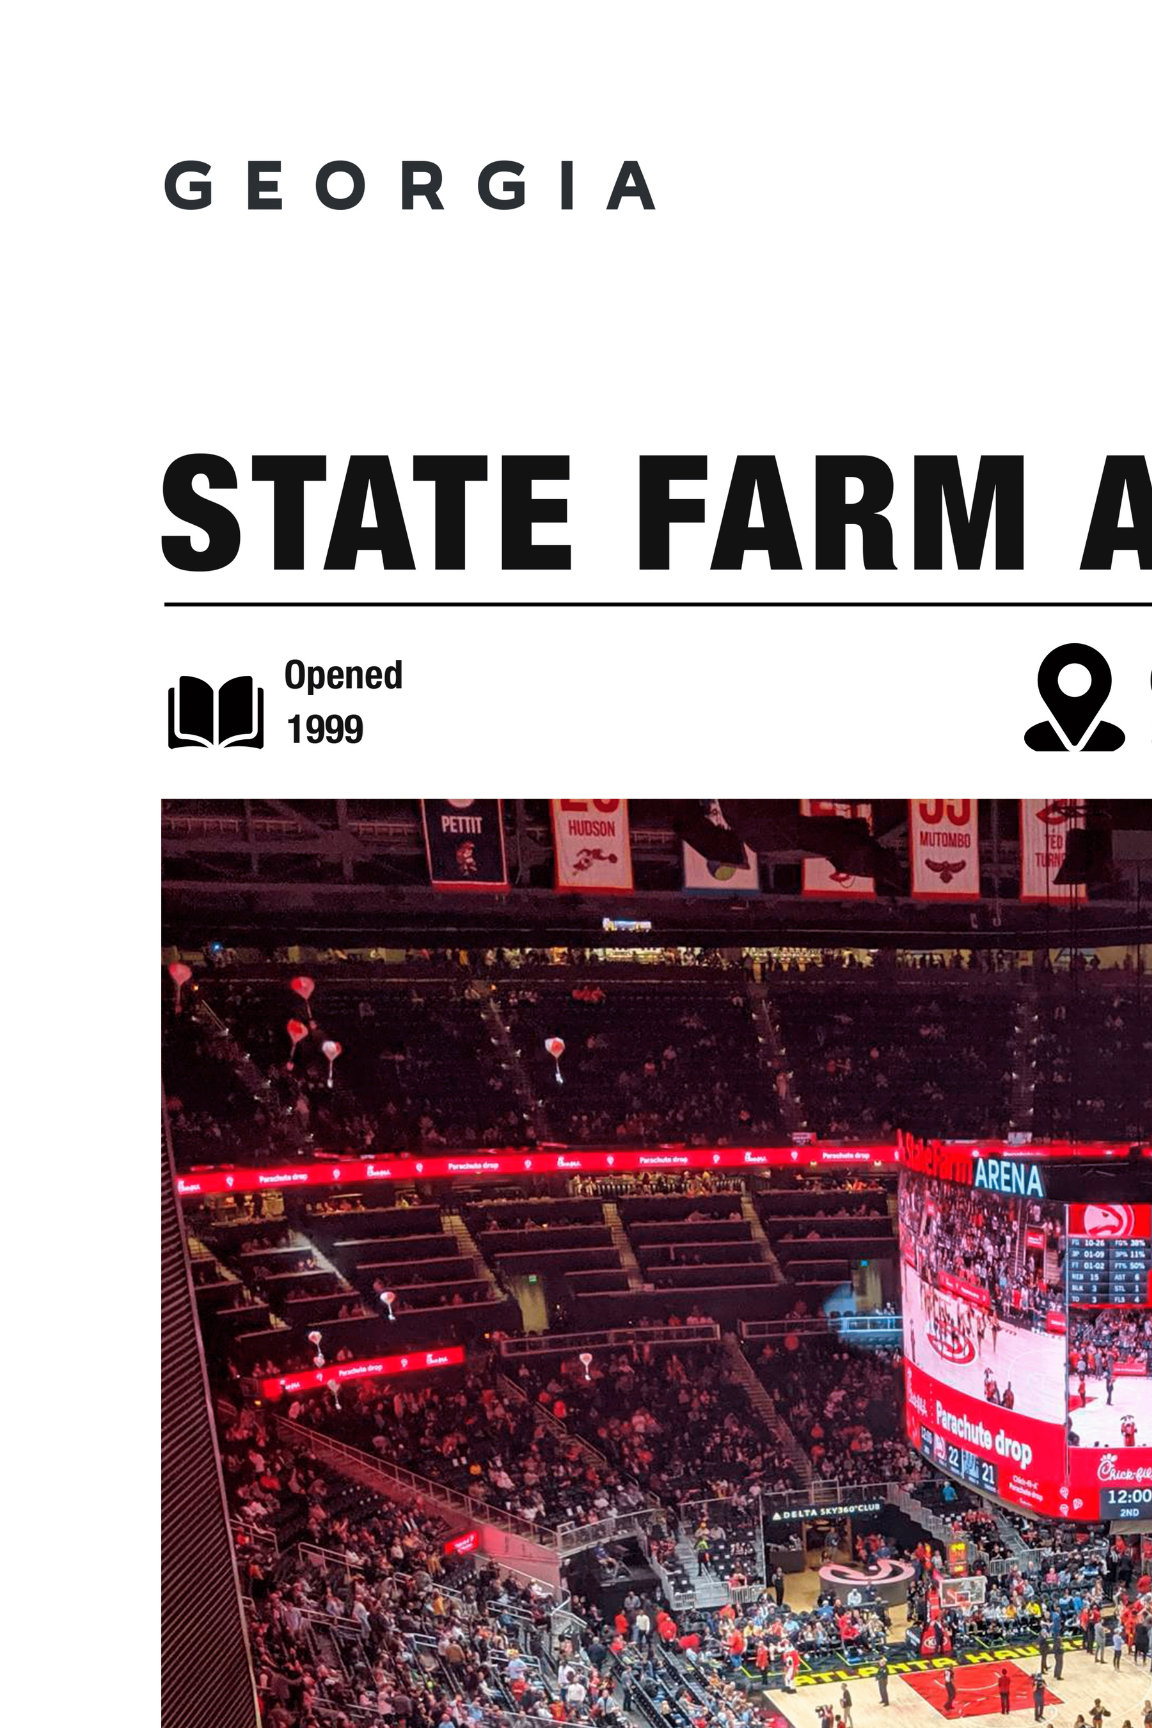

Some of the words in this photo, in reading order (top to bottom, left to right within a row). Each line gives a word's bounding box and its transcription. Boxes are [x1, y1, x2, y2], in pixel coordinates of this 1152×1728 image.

[441, 815, 483, 834] PETTIT
[568, 820, 616, 837] HUDSON
[920, 831, 971, 848] MUTOMBO
[1045, 834, 1063, 849] TED
[1035, 852, 1067, 868] TURN
[975, 1157, 1044, 1198] ARENA
[1083, 1250, 1105, 1259] 01-09
[1083, 1262, 1105, 1270] 01-02
[1090, 1273, 1100, 1281] 15
[935, 1400, 993, 1451] Parachute
[994, 1429, 1033, 1470] drop
[948, 1446, 959, 1468] 22
[981, 1462, 995, 1486] 21
[1108, 1488, 1152, 1504] 12:00
[783, 1508, 818, 1519] DELTA
[1119, 1508, 1140, 1518] 2ND
